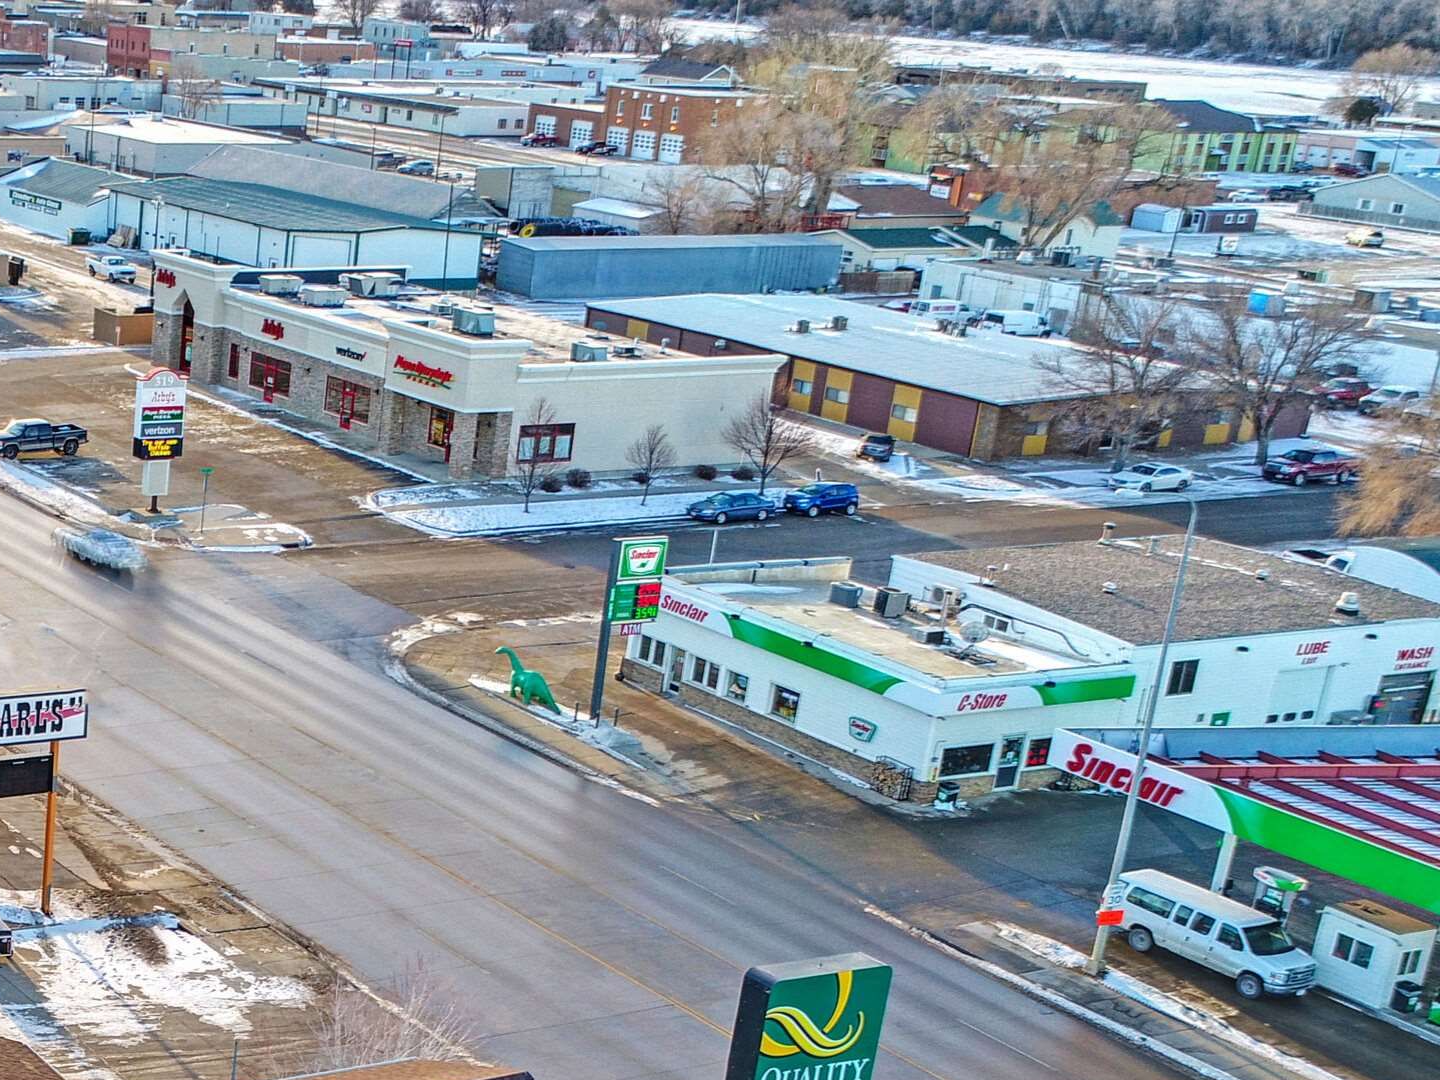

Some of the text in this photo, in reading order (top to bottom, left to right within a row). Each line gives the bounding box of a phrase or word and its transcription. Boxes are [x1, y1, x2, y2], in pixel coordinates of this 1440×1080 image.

[144, 427, 175, 435] verizon
[631, 549, 657, 559] Sinclair
[661, 595, 709, 622] Sinclair
[621, 624, 641, 635] ATM
[1296, 641, 1331, 656] LUBE
[1395, 647, 1434, 660] WASH
[957, 694, 1007, 711] C-Store
